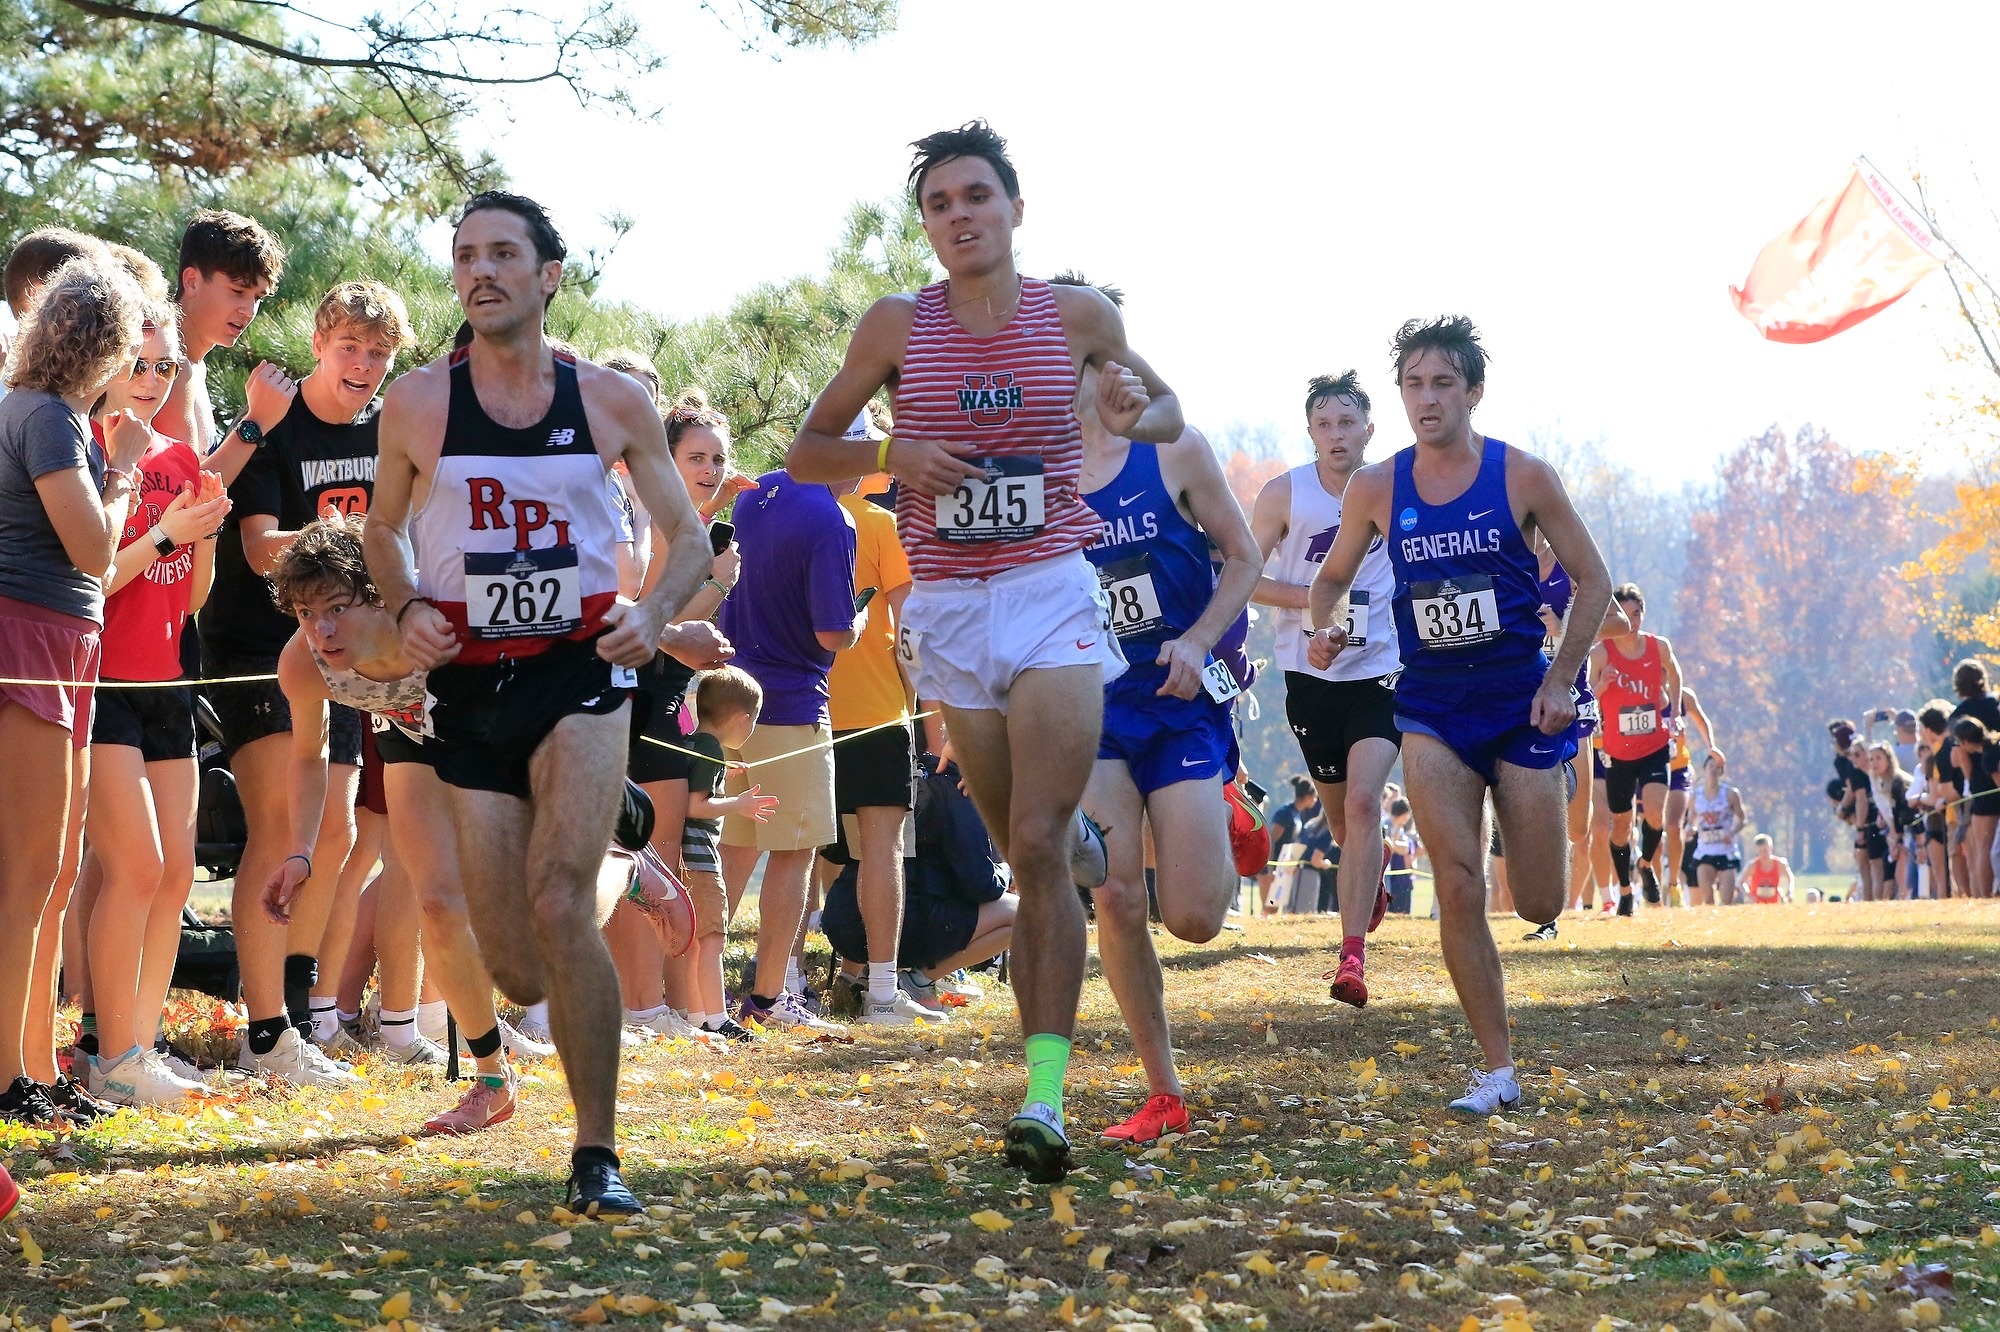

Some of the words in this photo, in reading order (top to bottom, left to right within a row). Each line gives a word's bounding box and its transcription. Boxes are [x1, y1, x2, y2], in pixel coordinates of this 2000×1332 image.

[957, 386, 1023, 411] WASH
[465, 477, 571, 551] RPI
[953, 484, 1027, 528] 345
[1401, 528, 1500, 563] GENERALS
[487, 578, 562, 625] 262
[1425, 598, 1485, 638] 334
[1617, 673, 1652, 699] CMU
[1628, 714, 1650, 731] 118
